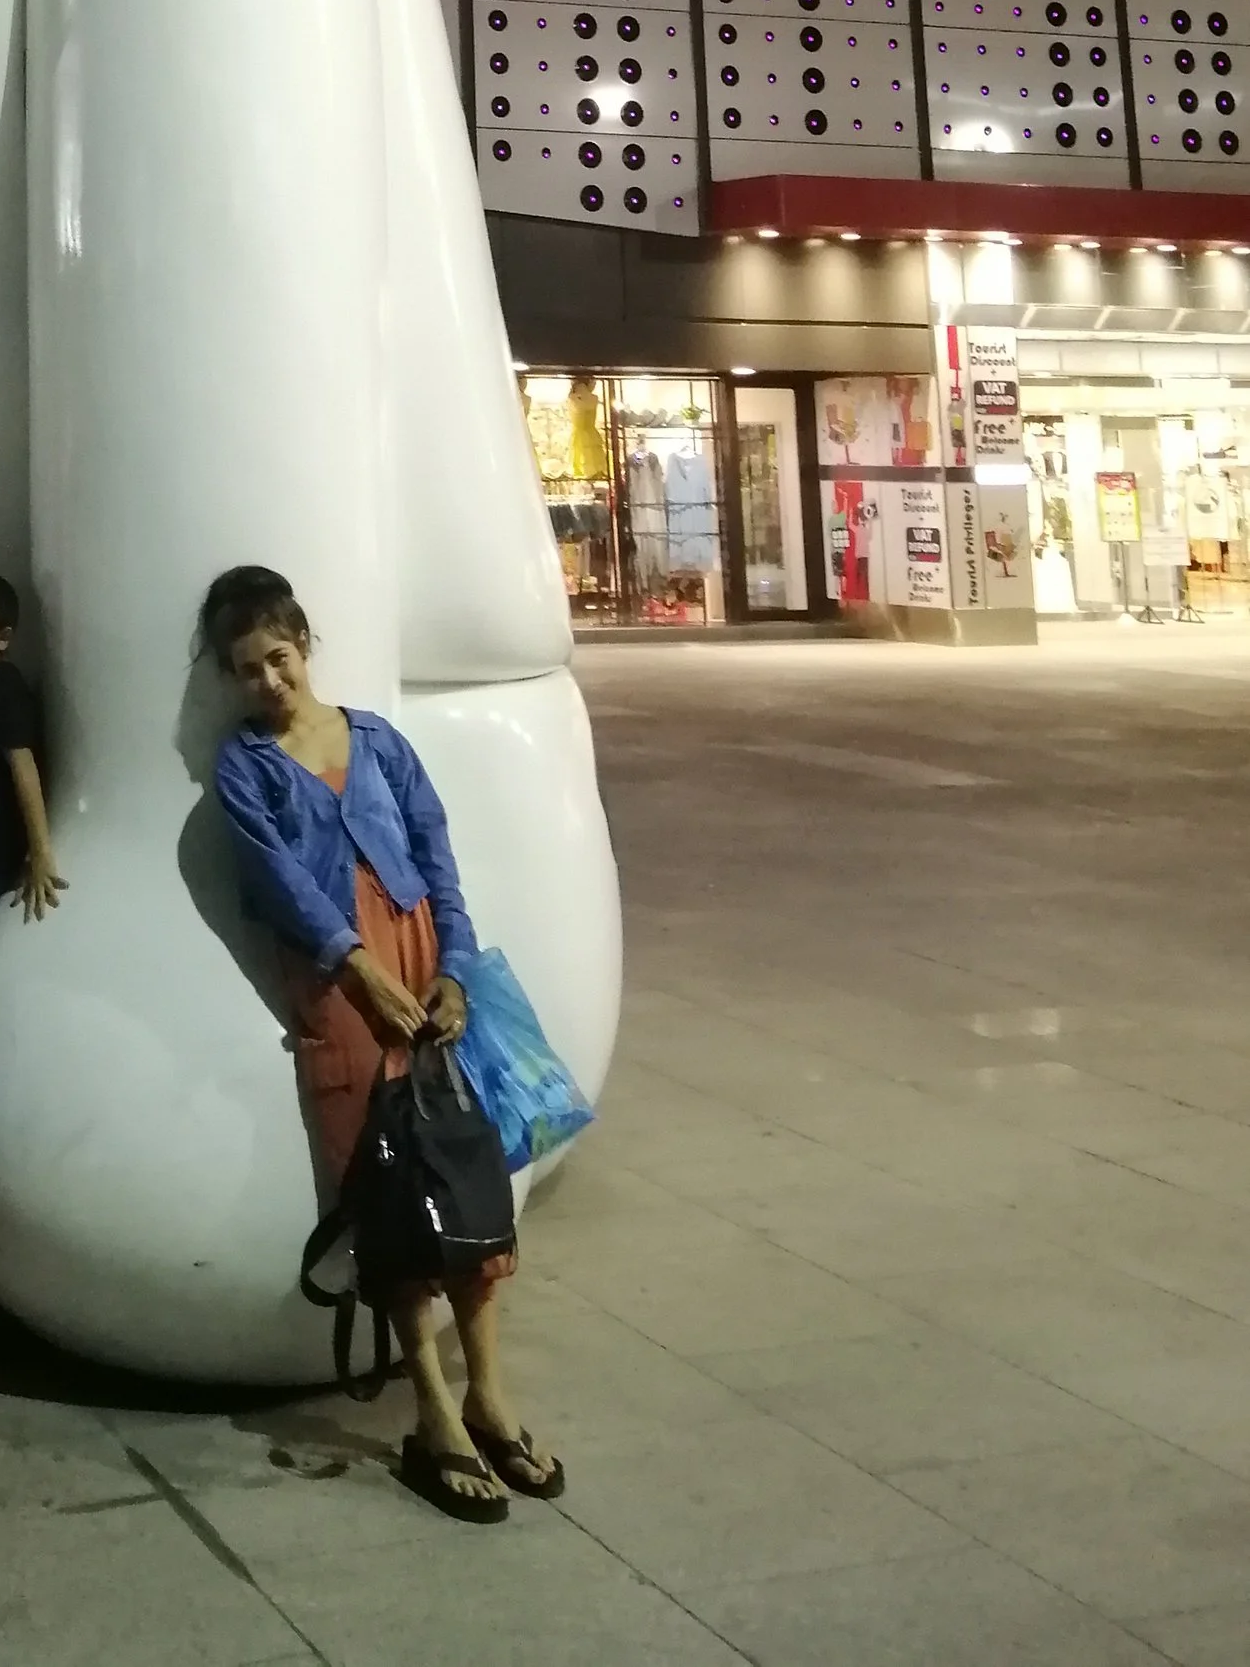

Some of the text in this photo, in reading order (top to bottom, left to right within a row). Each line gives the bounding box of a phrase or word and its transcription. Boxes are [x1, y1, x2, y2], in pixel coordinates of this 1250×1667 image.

[969, 342, 1007, 354] Tourist
[970, 355, 1016, 366] Discount
[981, 381, 1007, 394] VAT
[975, 394, 1016, 406] REFUND
[974, 419, 1006, 434] Free
[912, 528, 934, 541] VAT
[908, 566, 933, 582] Free
